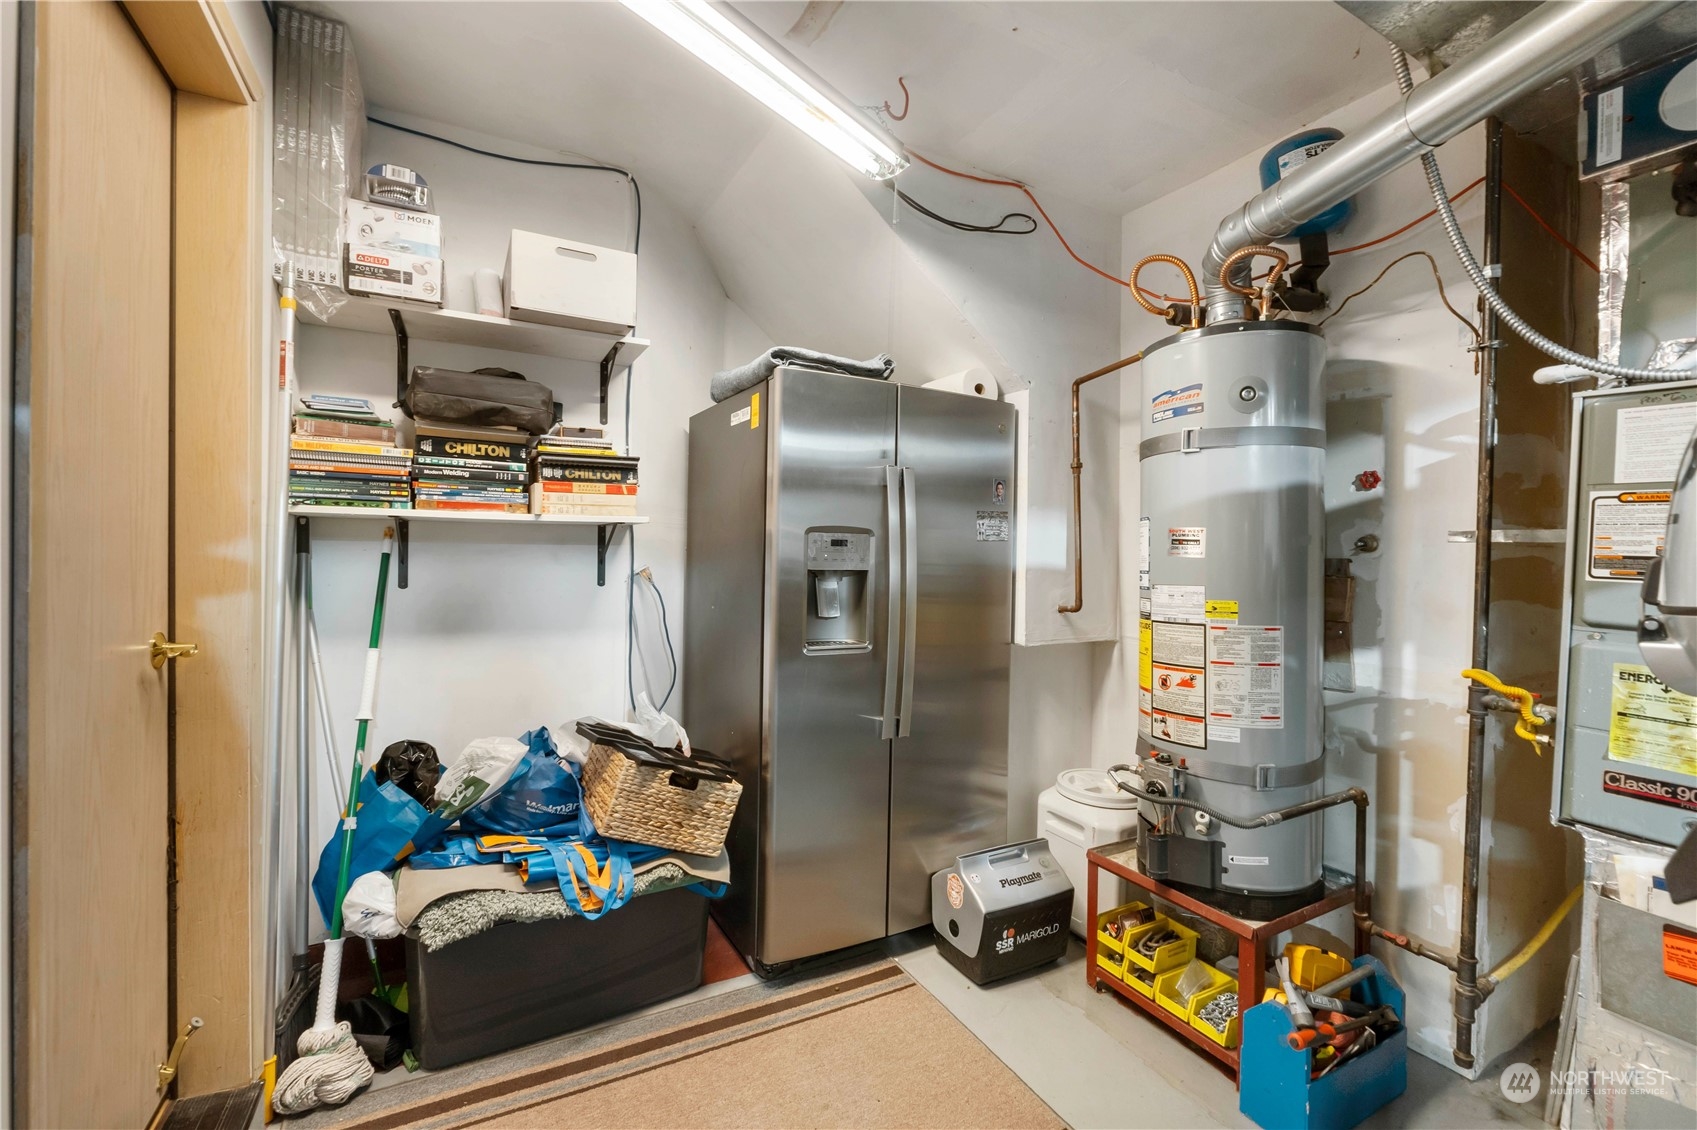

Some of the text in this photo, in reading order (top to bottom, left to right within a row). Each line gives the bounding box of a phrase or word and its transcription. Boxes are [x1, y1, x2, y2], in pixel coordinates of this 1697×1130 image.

[407, 215, 434, 226] MOEN
[355, 265, 384, 274] PORTER
[445, 442, 510, 458] CHILTON
[442, 469, 470, 477] Welding
[565, 468, 621, 480] CHILTON
[1619, 672, 1664, 686] ENERG
[1604, 772, 1672, 798] Classic
[526, 800, 579, 813] Walmar
[999, 872, 1042, 888] Playmate
[1016, 923, 1060, 945] MARIGOLD
[995, 938, 1014, 950] SSR
